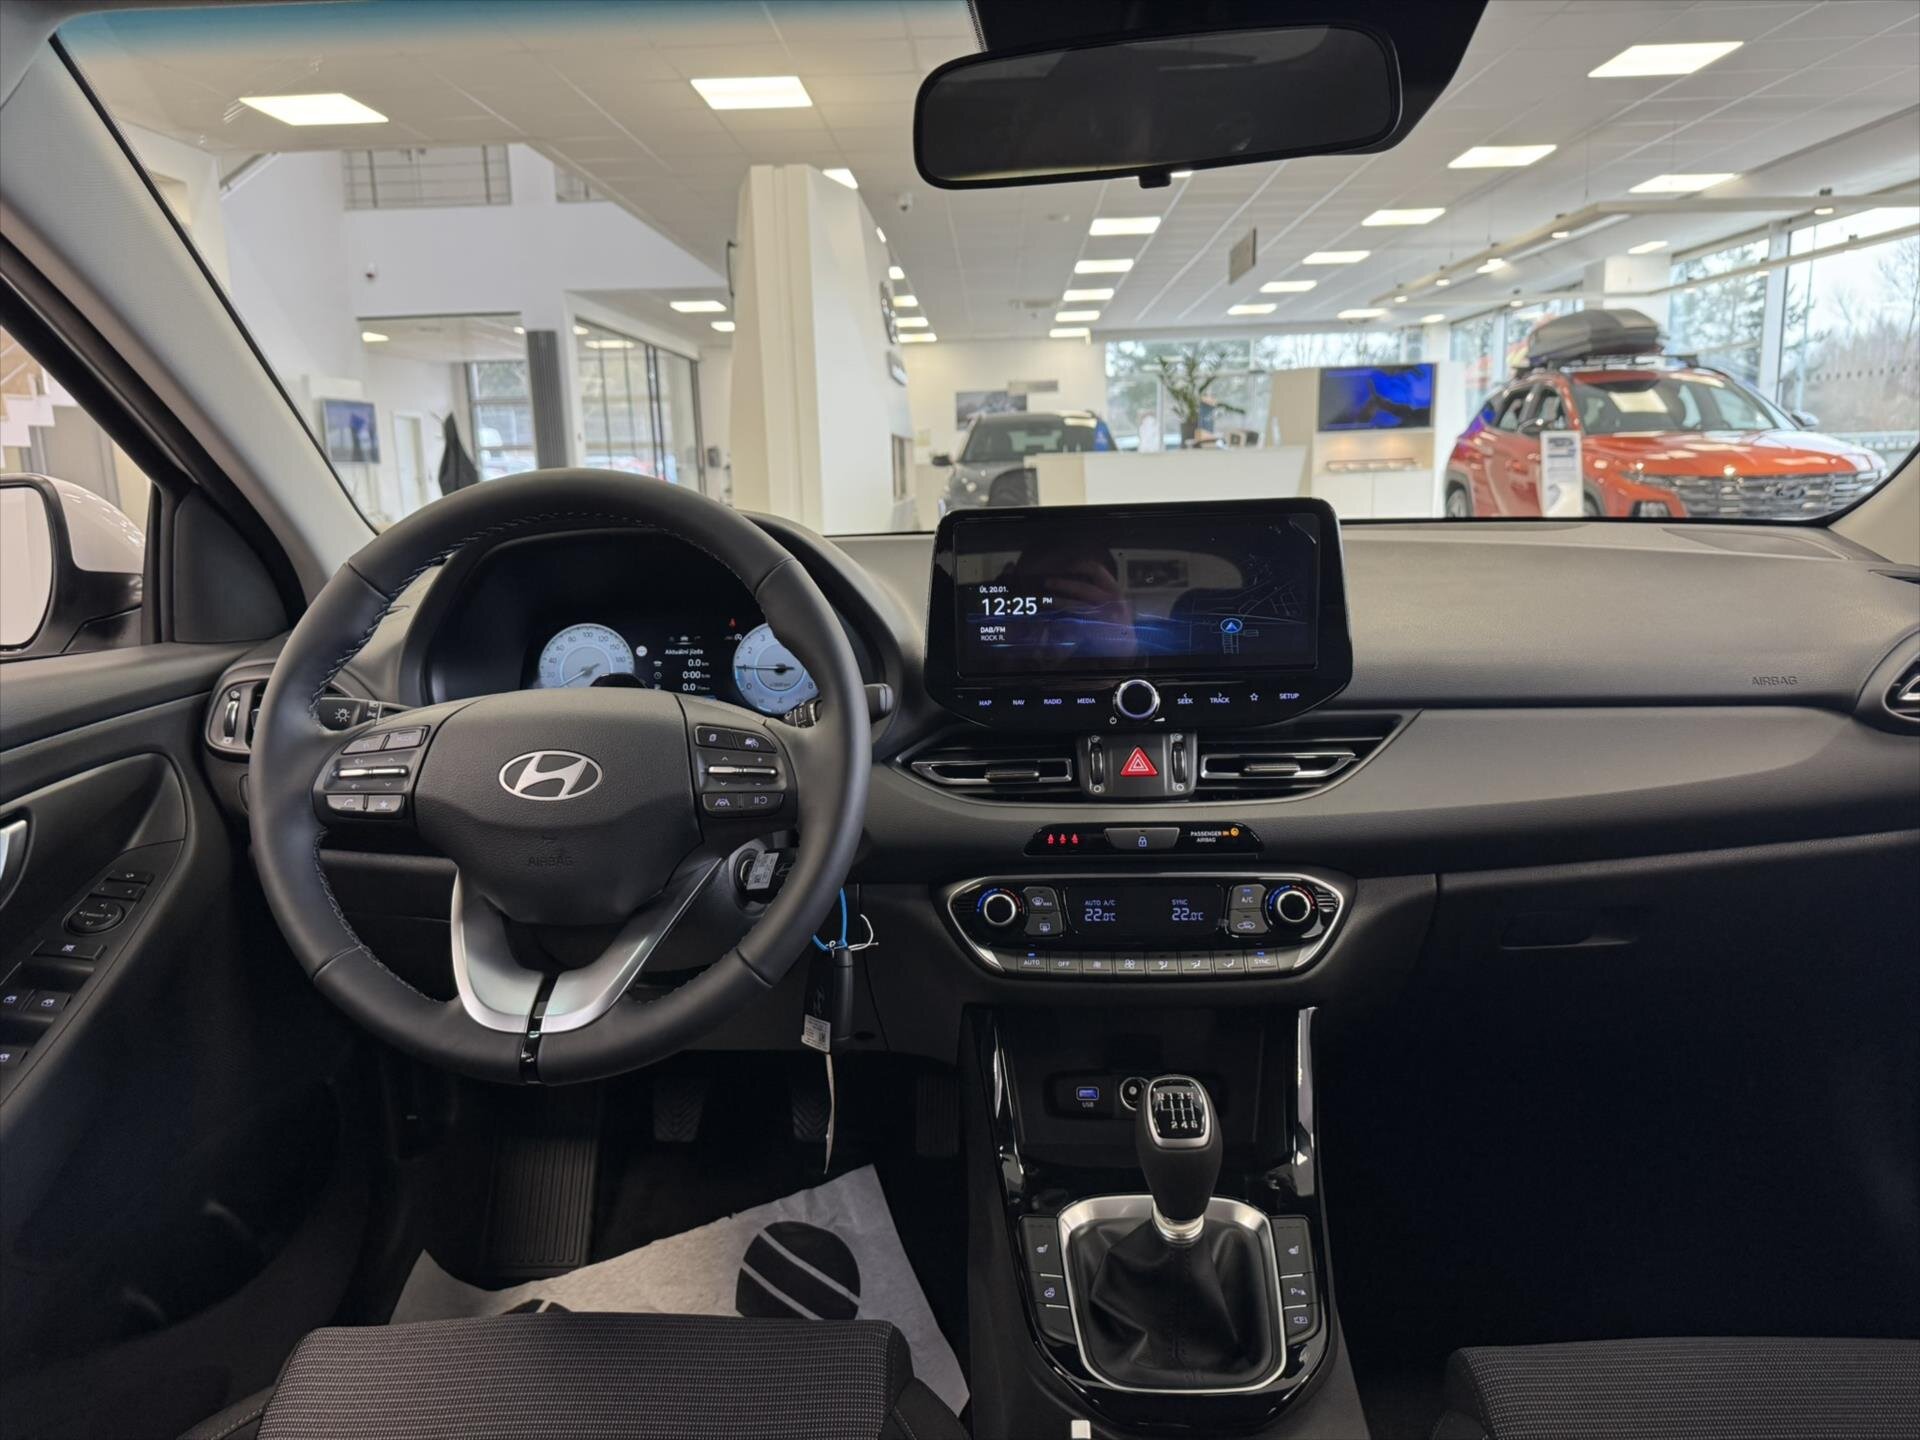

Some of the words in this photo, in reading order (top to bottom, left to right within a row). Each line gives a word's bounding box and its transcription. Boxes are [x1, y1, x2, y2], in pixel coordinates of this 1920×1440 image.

[982, 597, 1037, 616] 12:25
[980, 626, 1006, 634] DAB/FM
[747, 647, 753, 655] 2
[687, 658, 701, 667] 0.0
[682, 670, 701, 679] 0:00
[1751, 676, 1799, 687] AIRBAG
[682, 683, 696, 692] 0.0
[1279, 692, 1300, 700] SETUP
[1241, 896, 1255, 904] A/C
[1023, 959, 1041, 967] AUTO
[1057, 960, 1070, 968] OFF
[1171, 1120, 1178, 1129] 2
[1181, 1120, 1188, 1129] 4
[1191, 1120, 1198, 1129] 6
